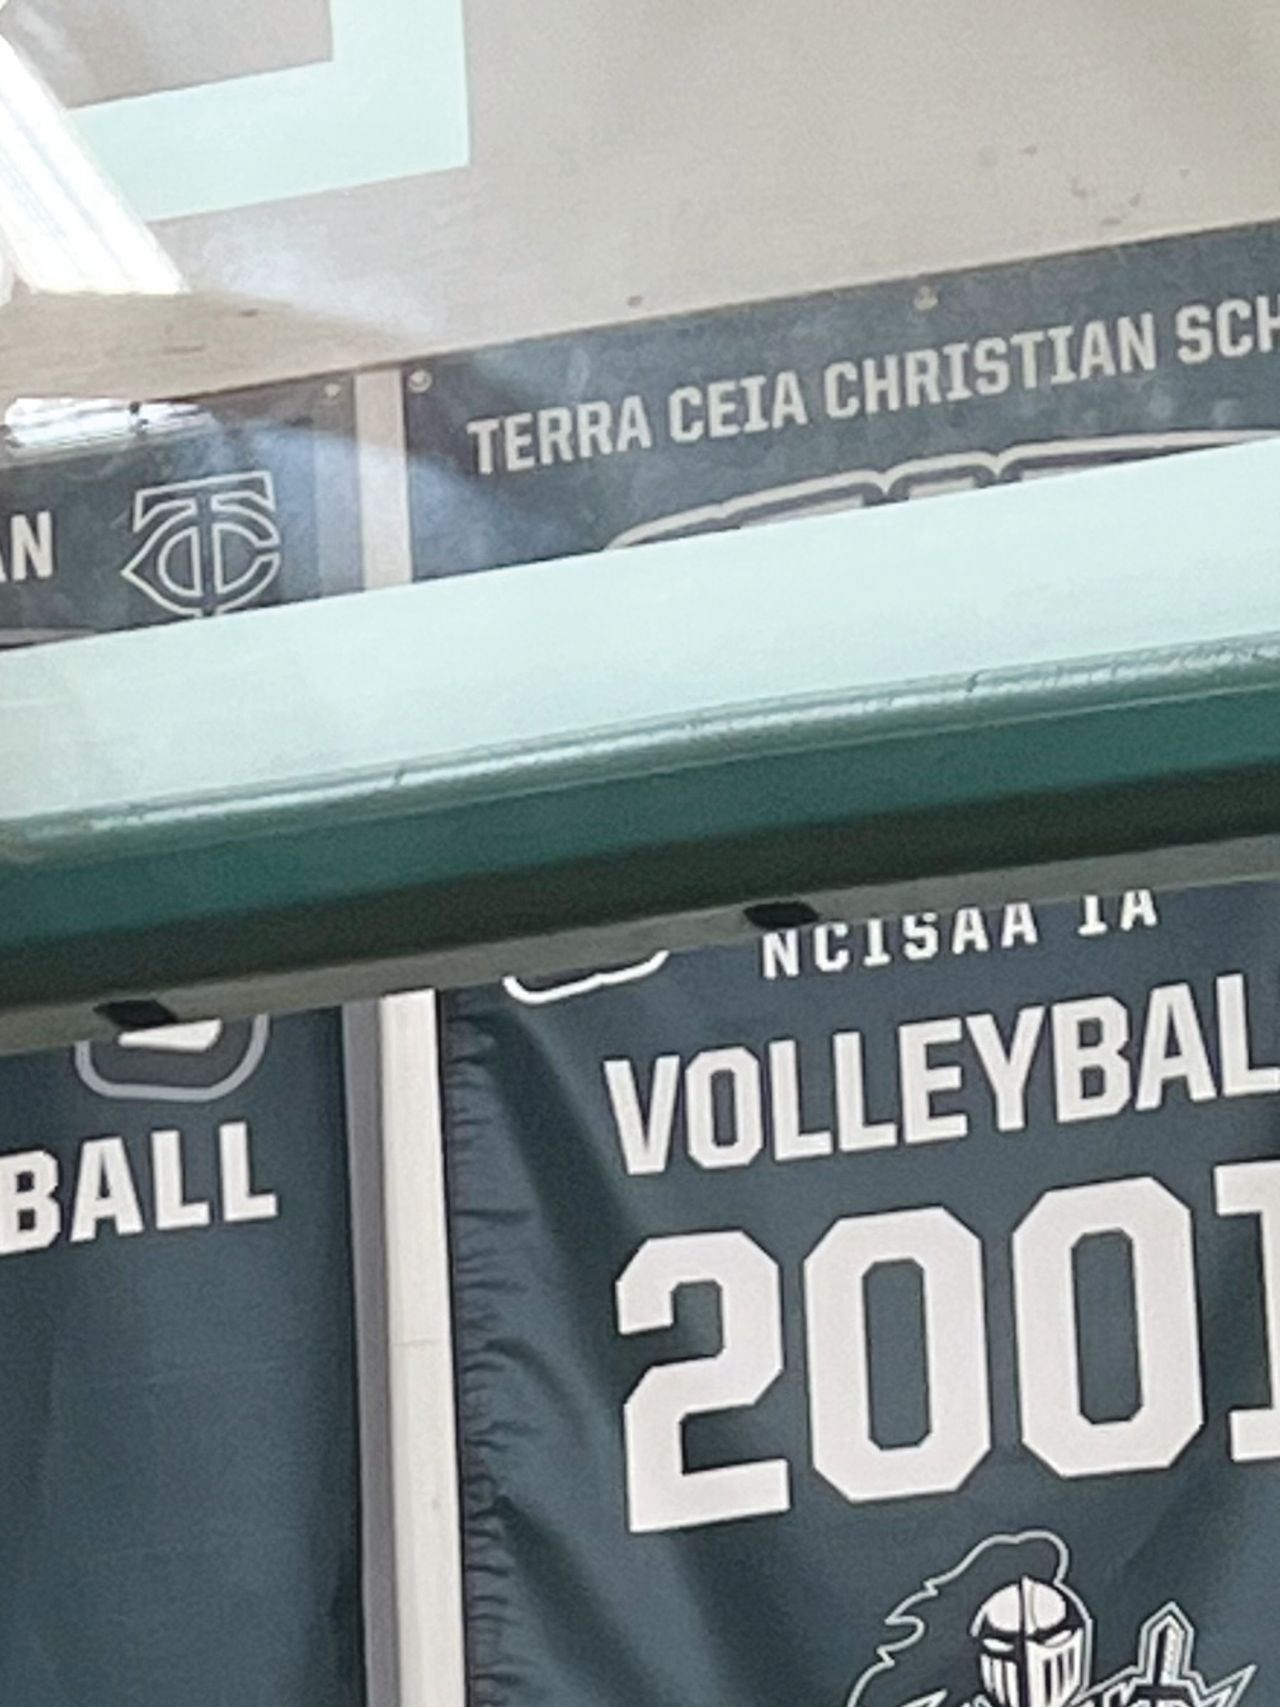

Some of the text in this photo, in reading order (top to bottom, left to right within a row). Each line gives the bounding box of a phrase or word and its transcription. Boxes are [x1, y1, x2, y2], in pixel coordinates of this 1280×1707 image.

[466, 394, 652, 476] TERRA
[668, 374, 808, 444] CEIA
[825, 311, 1157, 421] CHRISTIAN
